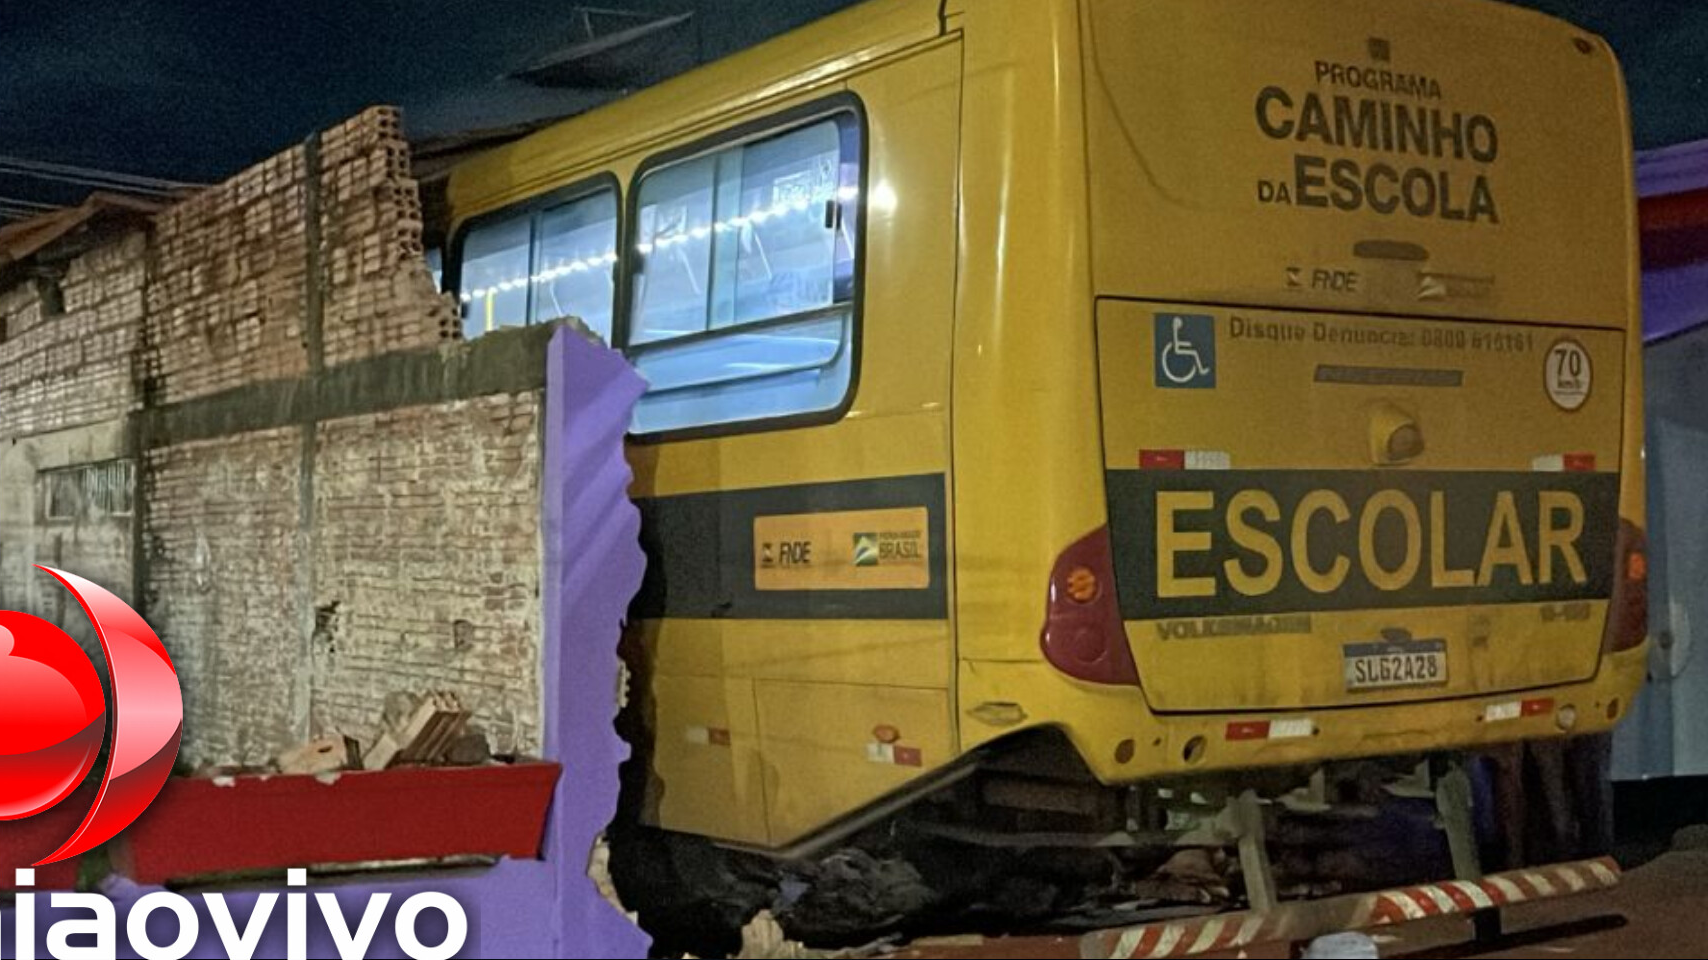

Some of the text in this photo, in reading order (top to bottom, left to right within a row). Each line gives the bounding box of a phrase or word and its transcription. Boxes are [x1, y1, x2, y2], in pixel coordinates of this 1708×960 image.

[1315, 60, 1441, 100] PROGRAMA
[1254, 85, 1499, 164] CAMINHO
[1257, 154, 1500, 224] DA ESCOLA
[1555, 349, 1582, 378] 70
[1155, 489, 1587, 599] ESCOLAR
[1355, 655, 1437, 683] SLG2A28
